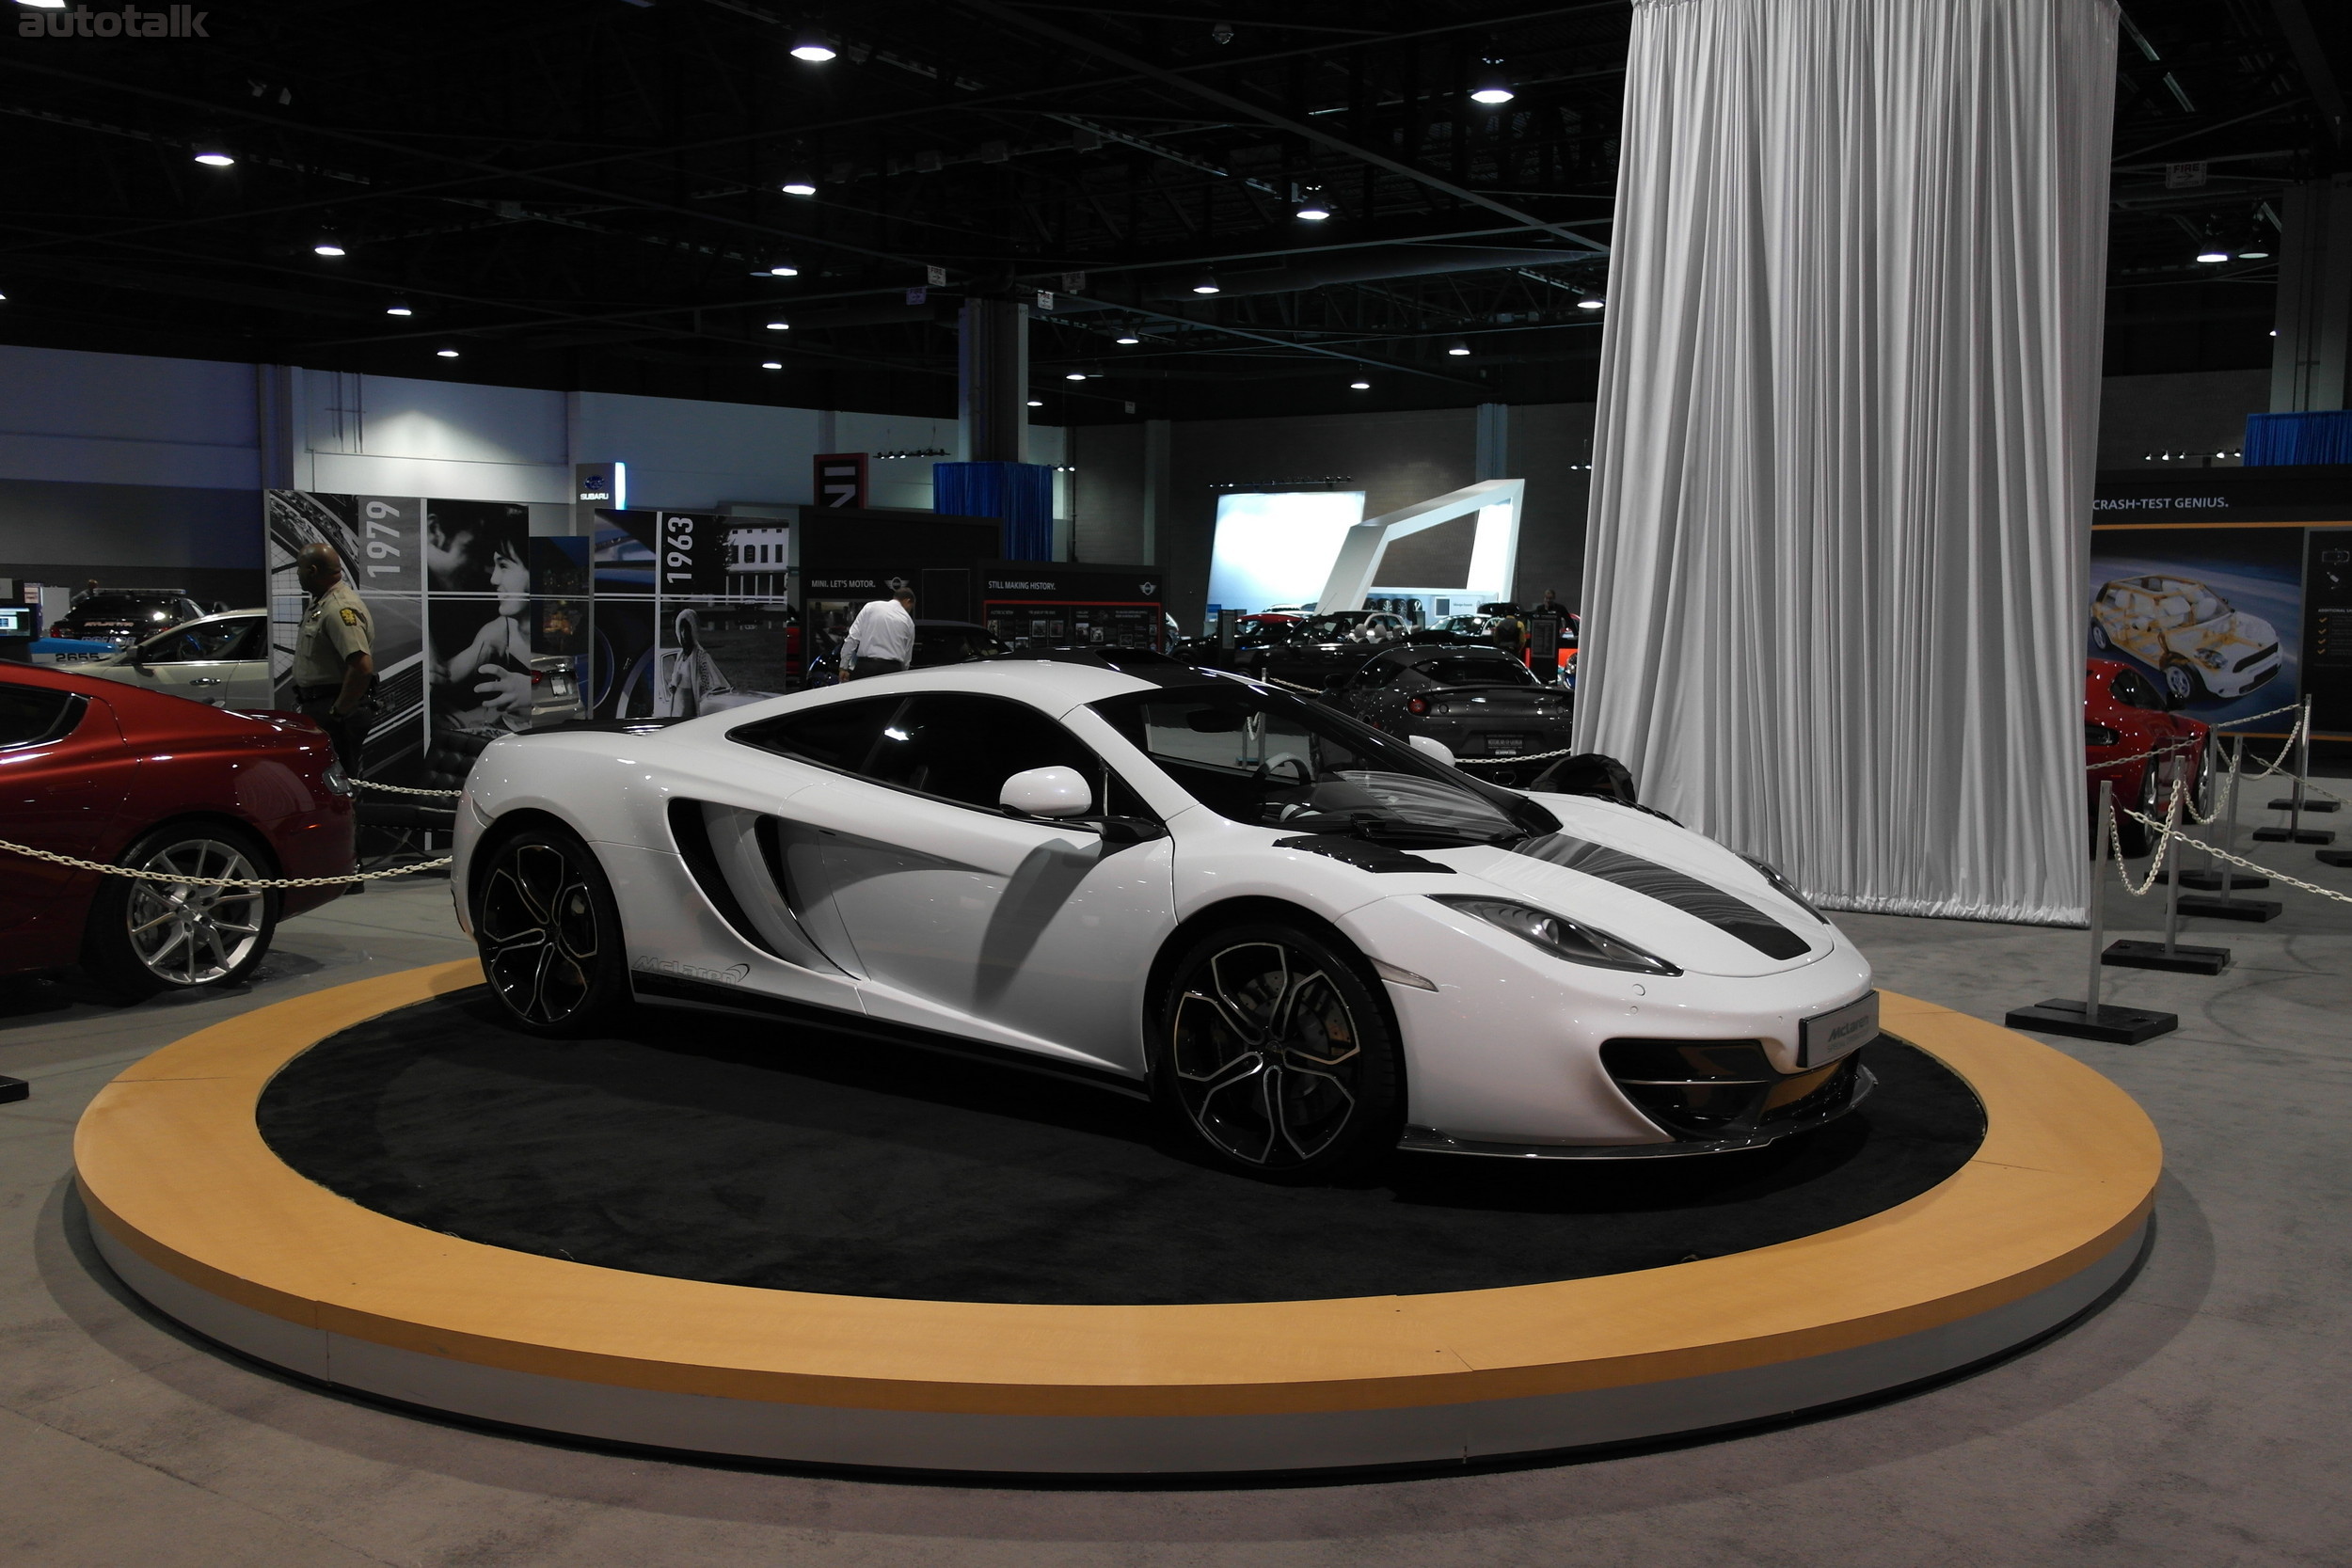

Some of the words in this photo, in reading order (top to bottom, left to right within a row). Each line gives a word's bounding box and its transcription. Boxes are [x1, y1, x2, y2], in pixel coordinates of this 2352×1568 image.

[580, 492, 609, 500] SUBARU
[2092, 498, 2171, 511] CRASH-TEST
[2174, 497, 2230, 509] GENIUS.
[366, 500, 401, 578] 1979
[666, 516, 693, 584] 1963
[811, 579, 829, 588] MINI.
[830, 579, 848, 588] LET'S
[849, 579, 876, 588] MOTOR.
[988, 580, 1004, 590] STILL
[1005, 581, 1029, 590] MAKING
[1030, 581, 1056, 591] HISTORY.
[631, 955, 737, 987] McLaren
[1828, 1016, 1869, 1042] McLaren
